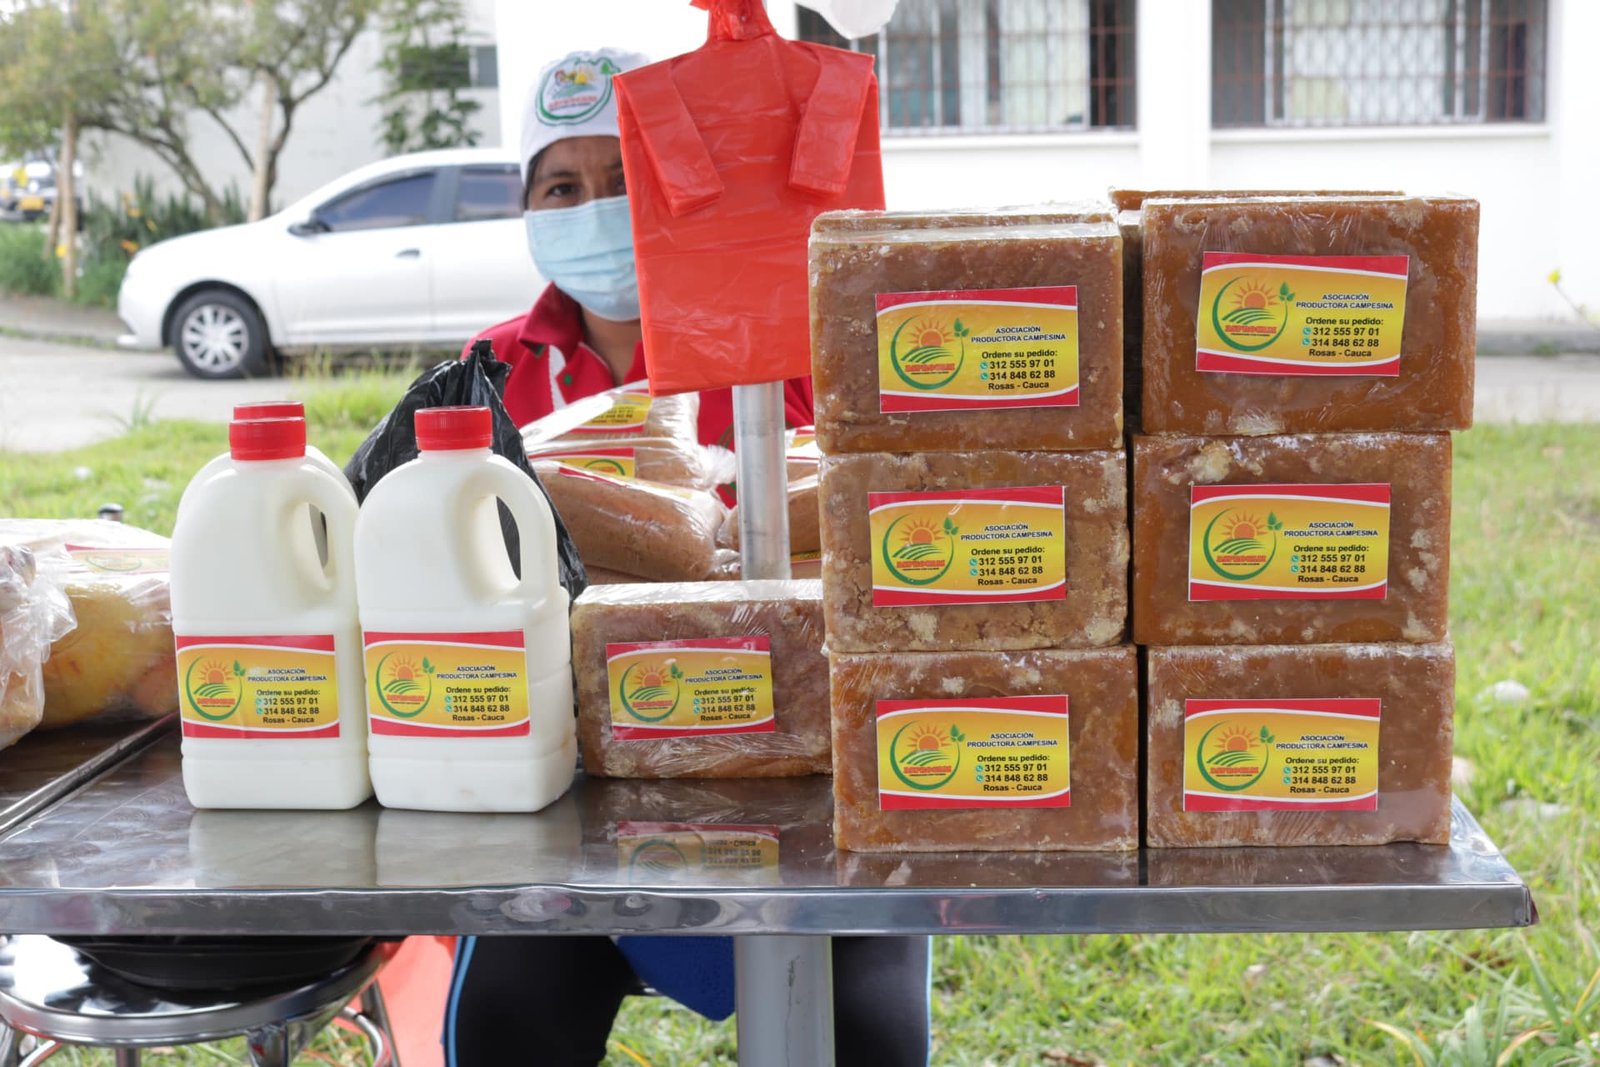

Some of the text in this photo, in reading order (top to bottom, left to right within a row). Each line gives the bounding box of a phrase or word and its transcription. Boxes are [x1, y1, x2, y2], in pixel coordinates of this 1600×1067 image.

[1352, 318, 1384, 327] pedido:
[1354, 328, 1366, 336] 97
[1368, 328, 1379, 336] 01
[1312, 339, 1329, 347] 314
[1353, 339, 1365, 347] 62
[982, 351, 1012, 359] Ordene
[1027, 349, 1058, 358] pedido:
[990, 361, 1007, 369] 312
[1030, 360, 1041, 368] 97
[990, 370, 1056, 380] 314 848 62 88
[988, 382, 1014, 390] Rosas
[1023, 381, 1049, 389] Cauca
[961, 533, 1009, 541] PRODUCTORA
[1015, 547, 1045, 555] pedido:
[1338, 545, 1369, 553] pedido:
[979, 558, 996, 566] 312
[999, 557, 1015, 565] 555
[979, 568, 996, 576] 314
[999, 568, 1016, 576] 848
[1018, 567, 1030, 575] 62
[1300, 565, 1365, 573] 314 848 62 88
[978, 578, 1004, 586] Rosas
[1012, 577, 1037, 585] Cauca
[1332, 575, 1359, 583] Cauca
[294, 689, 320, 697] pedido:
[1020, 755, 1050, 763] pedido:
[1329, 757, 1359, 765] pedido:
[984, 764, 1001, 772] 312
[1004, 764, 1021, 772] 555
[1292, 766, 1309, 774] 312
[985, 775, 1002, 783] 314
[1004, 774, 1021, 782] 848
[1024, 774, 1035, 782] 62
[1292, 777, 1309, 785] 314
